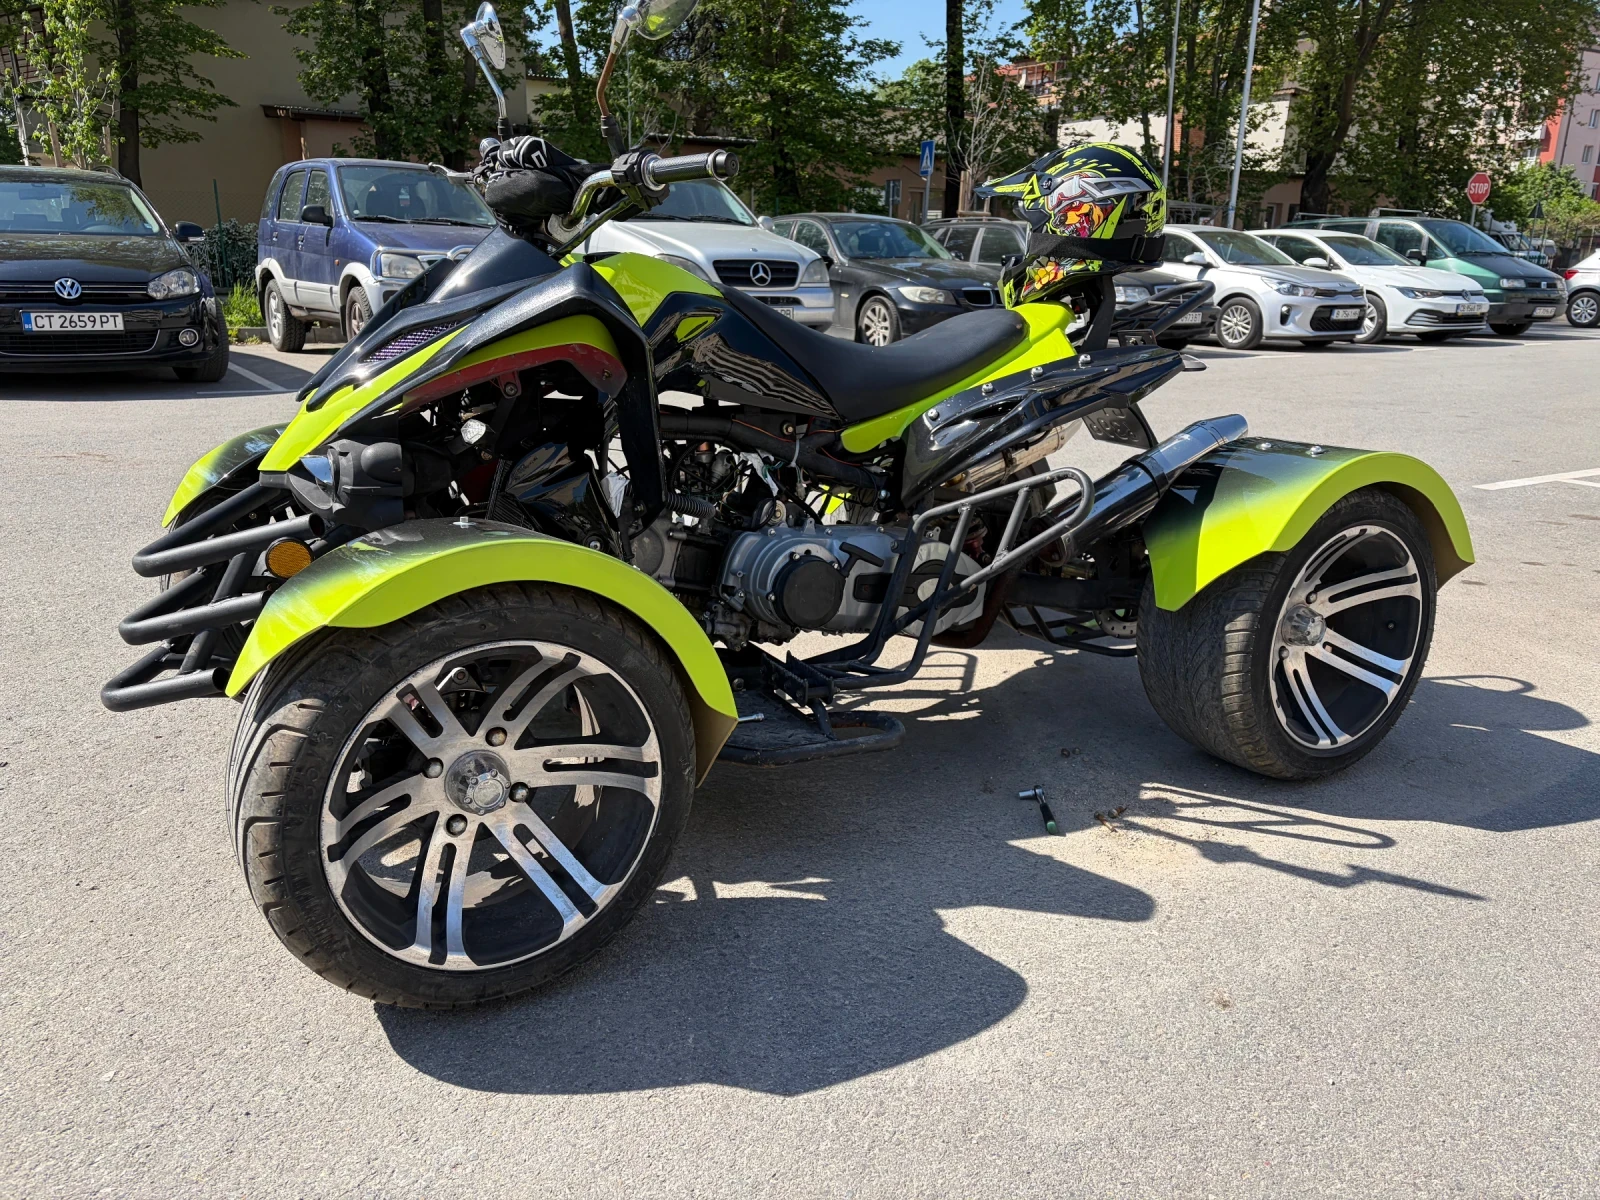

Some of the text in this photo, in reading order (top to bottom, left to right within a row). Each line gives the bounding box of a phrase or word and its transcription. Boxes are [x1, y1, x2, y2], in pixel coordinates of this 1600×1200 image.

[1470, 183, 1489, 194] STOP
[34, 314, 54, 329] CT
[58, 314, 97, 329] 2659
[100, 314, 119, 329] PT
